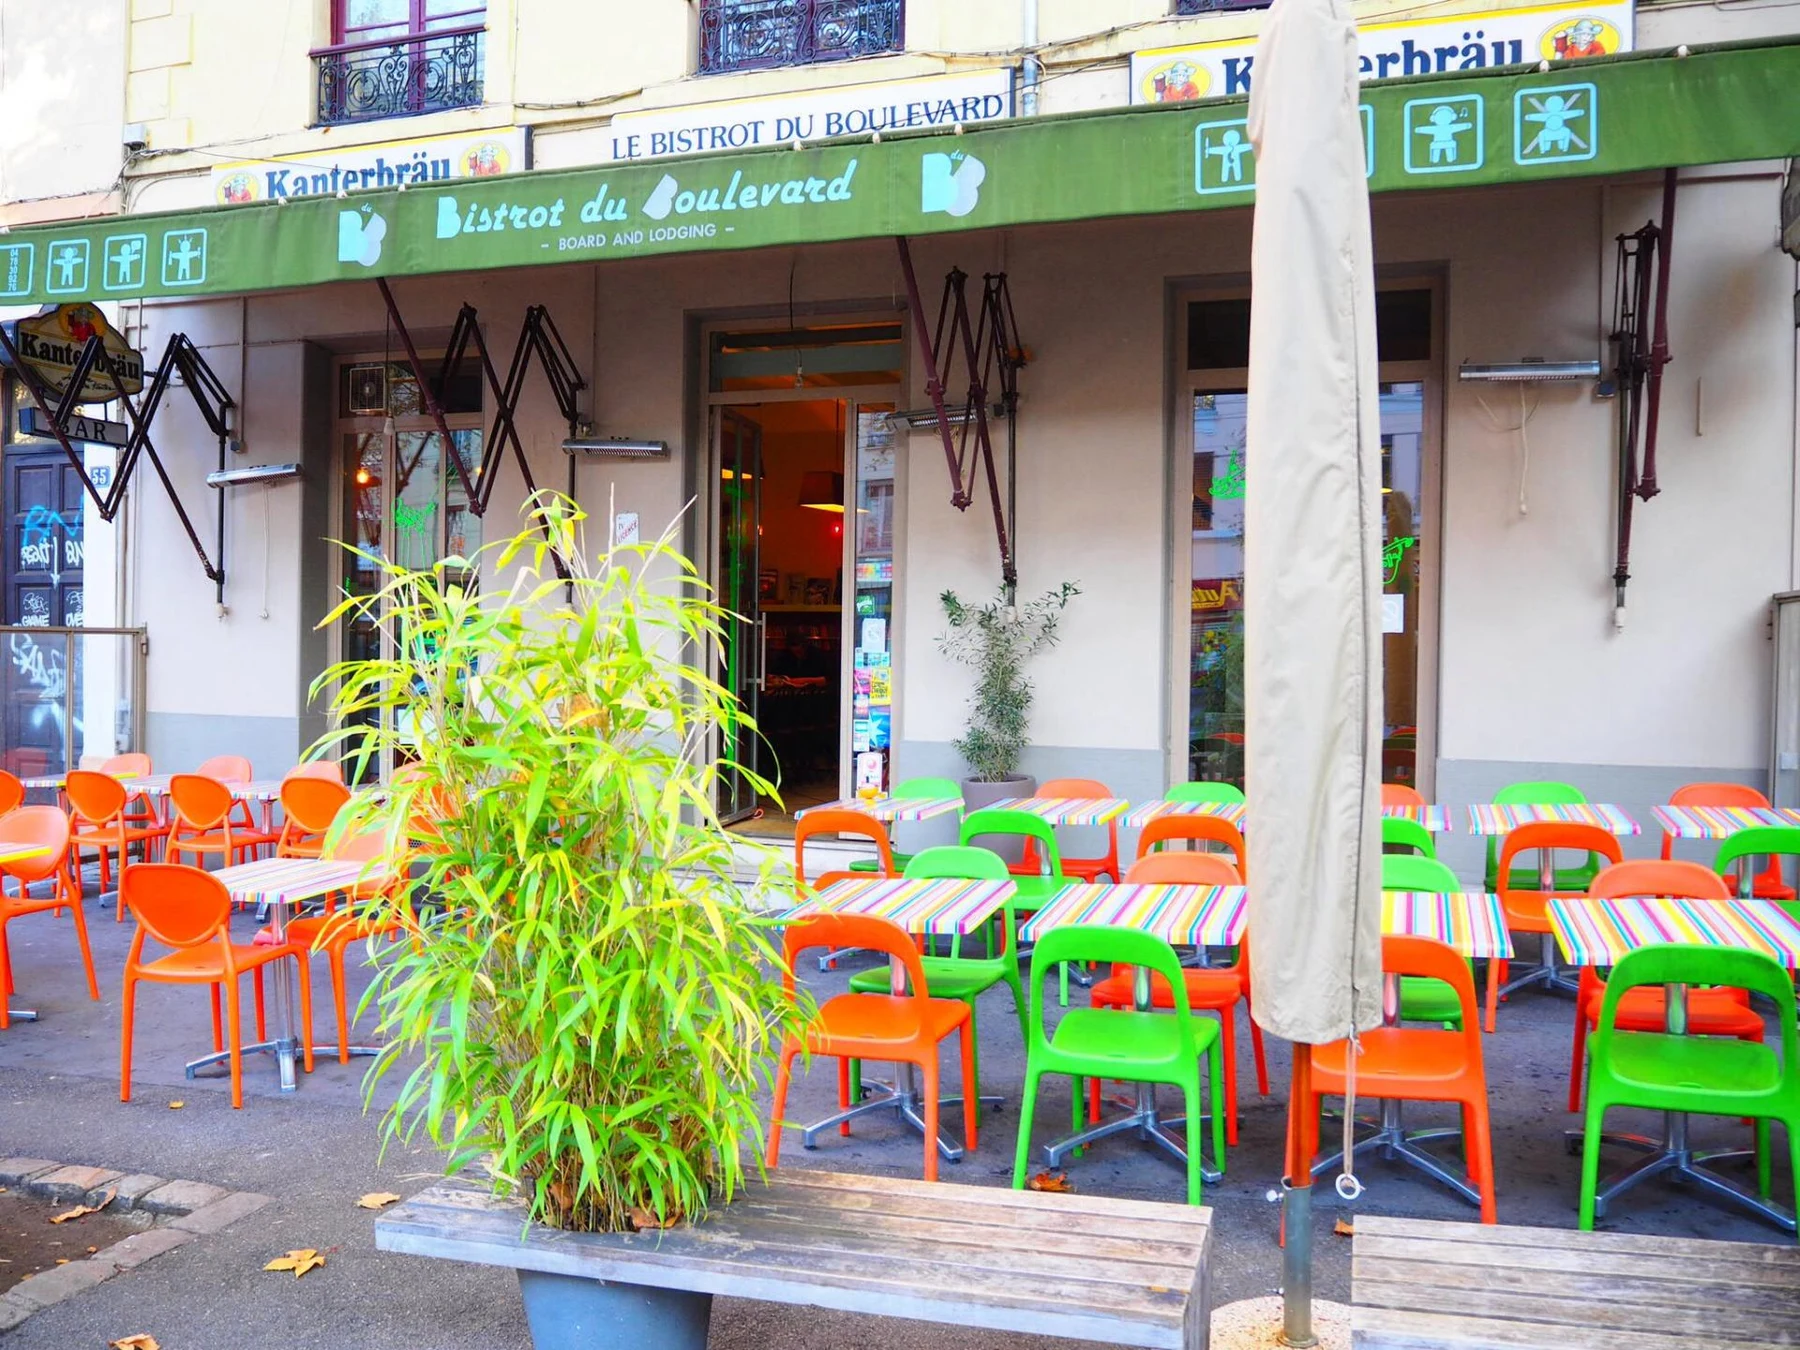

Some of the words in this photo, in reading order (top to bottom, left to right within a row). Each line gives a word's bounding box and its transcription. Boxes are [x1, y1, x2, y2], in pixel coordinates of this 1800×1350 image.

[1222, 30, 1523, 96] Kerbräu
[612, 134, 642, 160] LE
[650, 120, 766, 156] BISTROT
[775, 114, 814, 141] DU
[825, 94, 1004, 136] BOULEVARD
[265, 151, 451, 200] Kanterbräu
[436, 196, 565, 239] Bistrot
[580, 183, 628, 223] du
[641, 158, 858, 220] Boulevard
[559, 233, 606, 251] BOARD
[612, 230, 643, 247] AND
[649, 223, 716, 242] LODGING
[91, 468, 107, 485] 55
